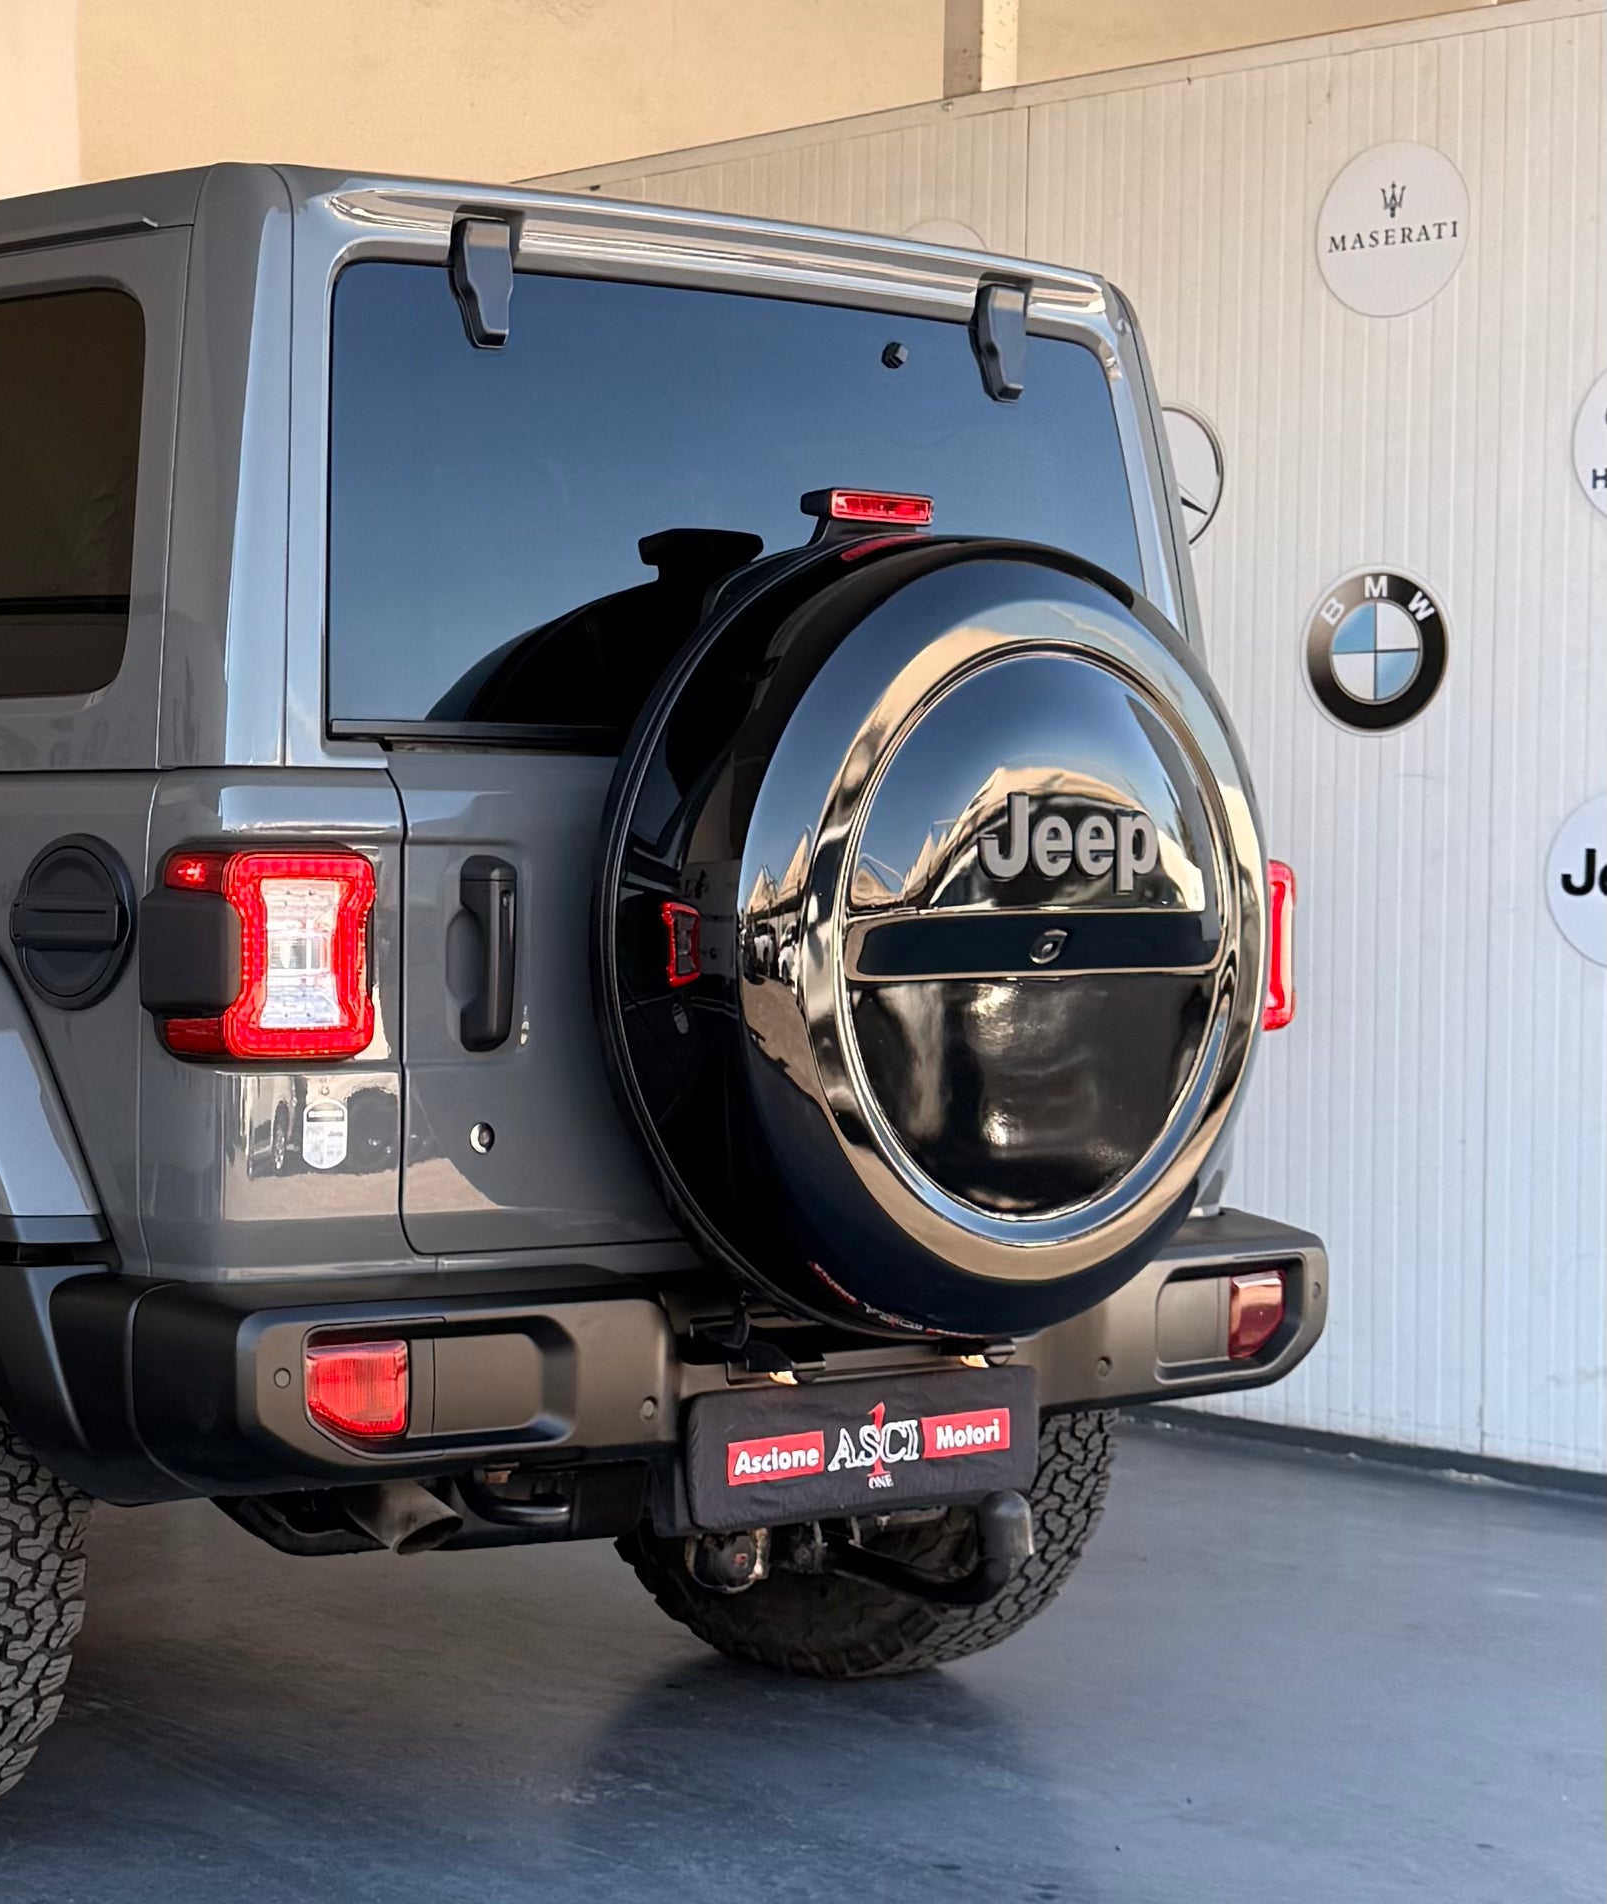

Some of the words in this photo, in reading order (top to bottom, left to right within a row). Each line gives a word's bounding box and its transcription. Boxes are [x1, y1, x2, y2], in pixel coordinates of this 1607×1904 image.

[1328, 221, 1458, 254] MASERATI
[1320, 575, 1435, 625] BMW
[978, 792, 1159, 894] Jeep
[733, 1445, 820, 1477] Ascione
[827, 1419, 920, 1473] ASCI
[935, 1418, 1000, 1451] Motori
[868, 1474, 894, 1490] ONE
